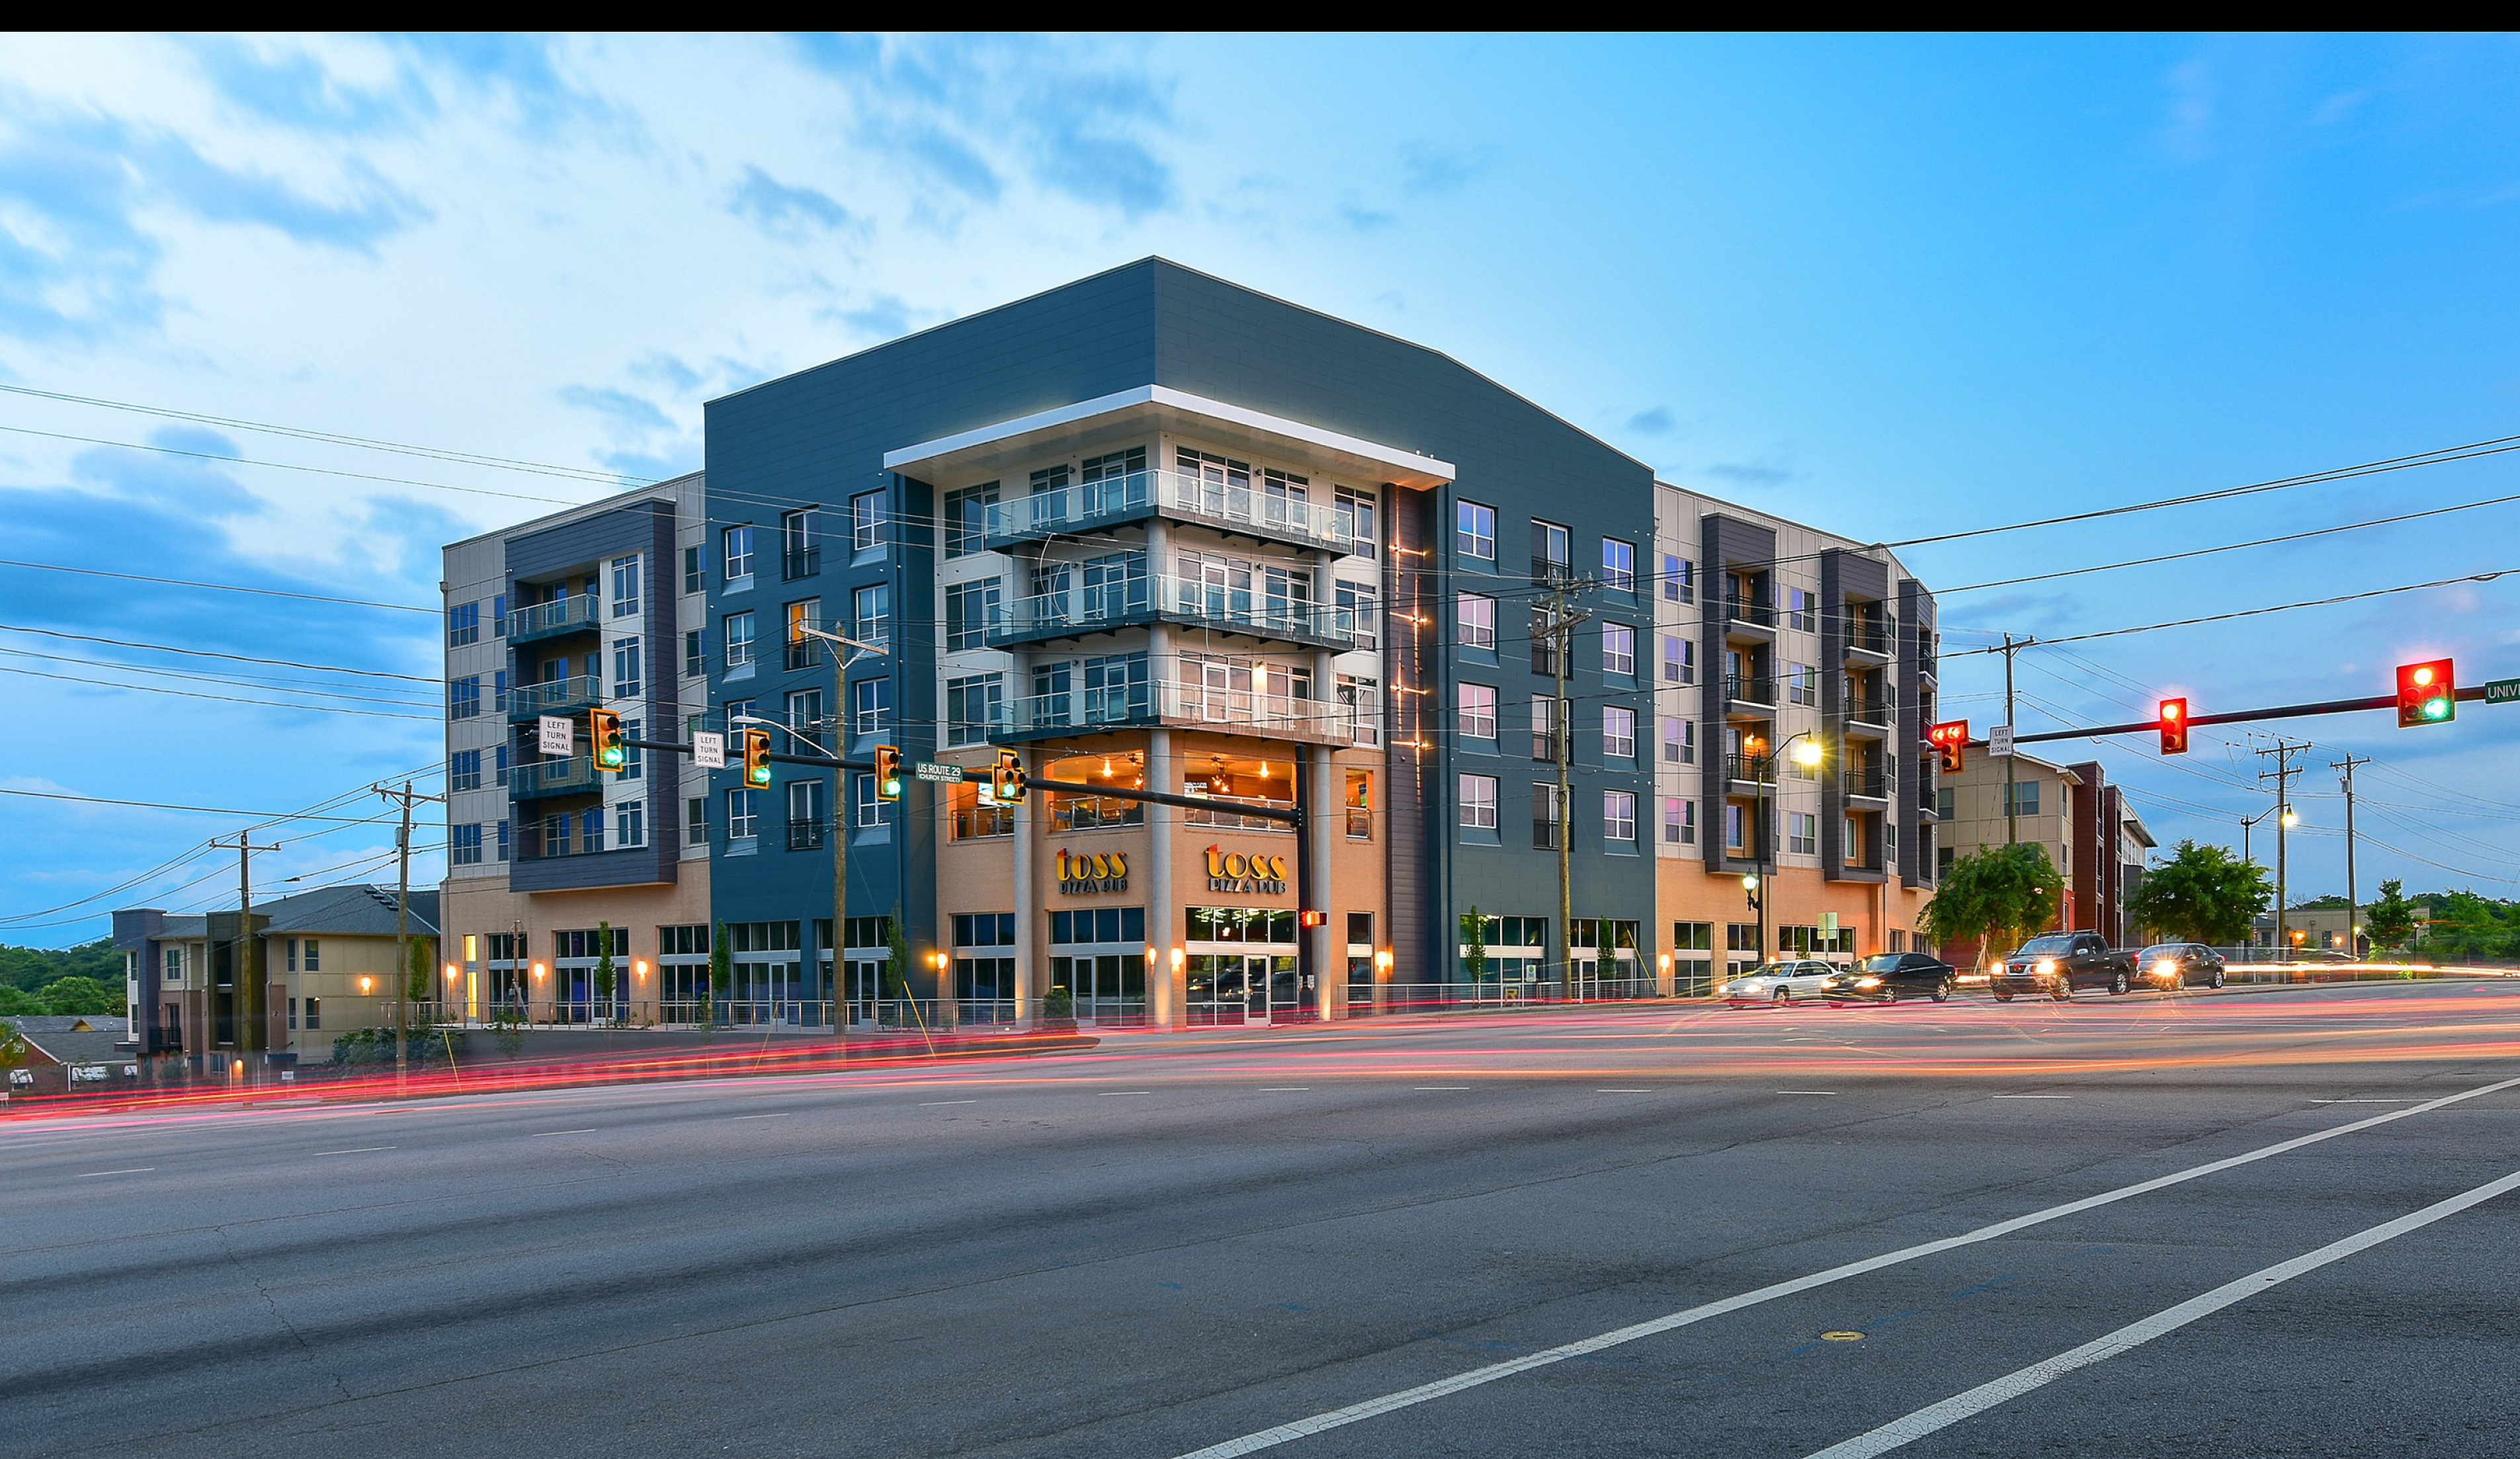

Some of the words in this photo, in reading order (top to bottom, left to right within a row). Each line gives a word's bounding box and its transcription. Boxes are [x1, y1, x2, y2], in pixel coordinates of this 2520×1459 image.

[2488, 684, 2520, 698] UNIV
[546, 731, 566, 739] TURN
[542, 741, 570, 751] SIGNAL
[917, 763, 927, 773] US
[928, 764, 950, 775] ROUTE
[952, 767, 961, 776] 29
[1058, 880, 1098, 894] PIZZA
[1101, 878, 1128, 892] PUB
[1209, 878, 1254, 894] PIZZA
[1258, 880, 1287, 894] PUB
